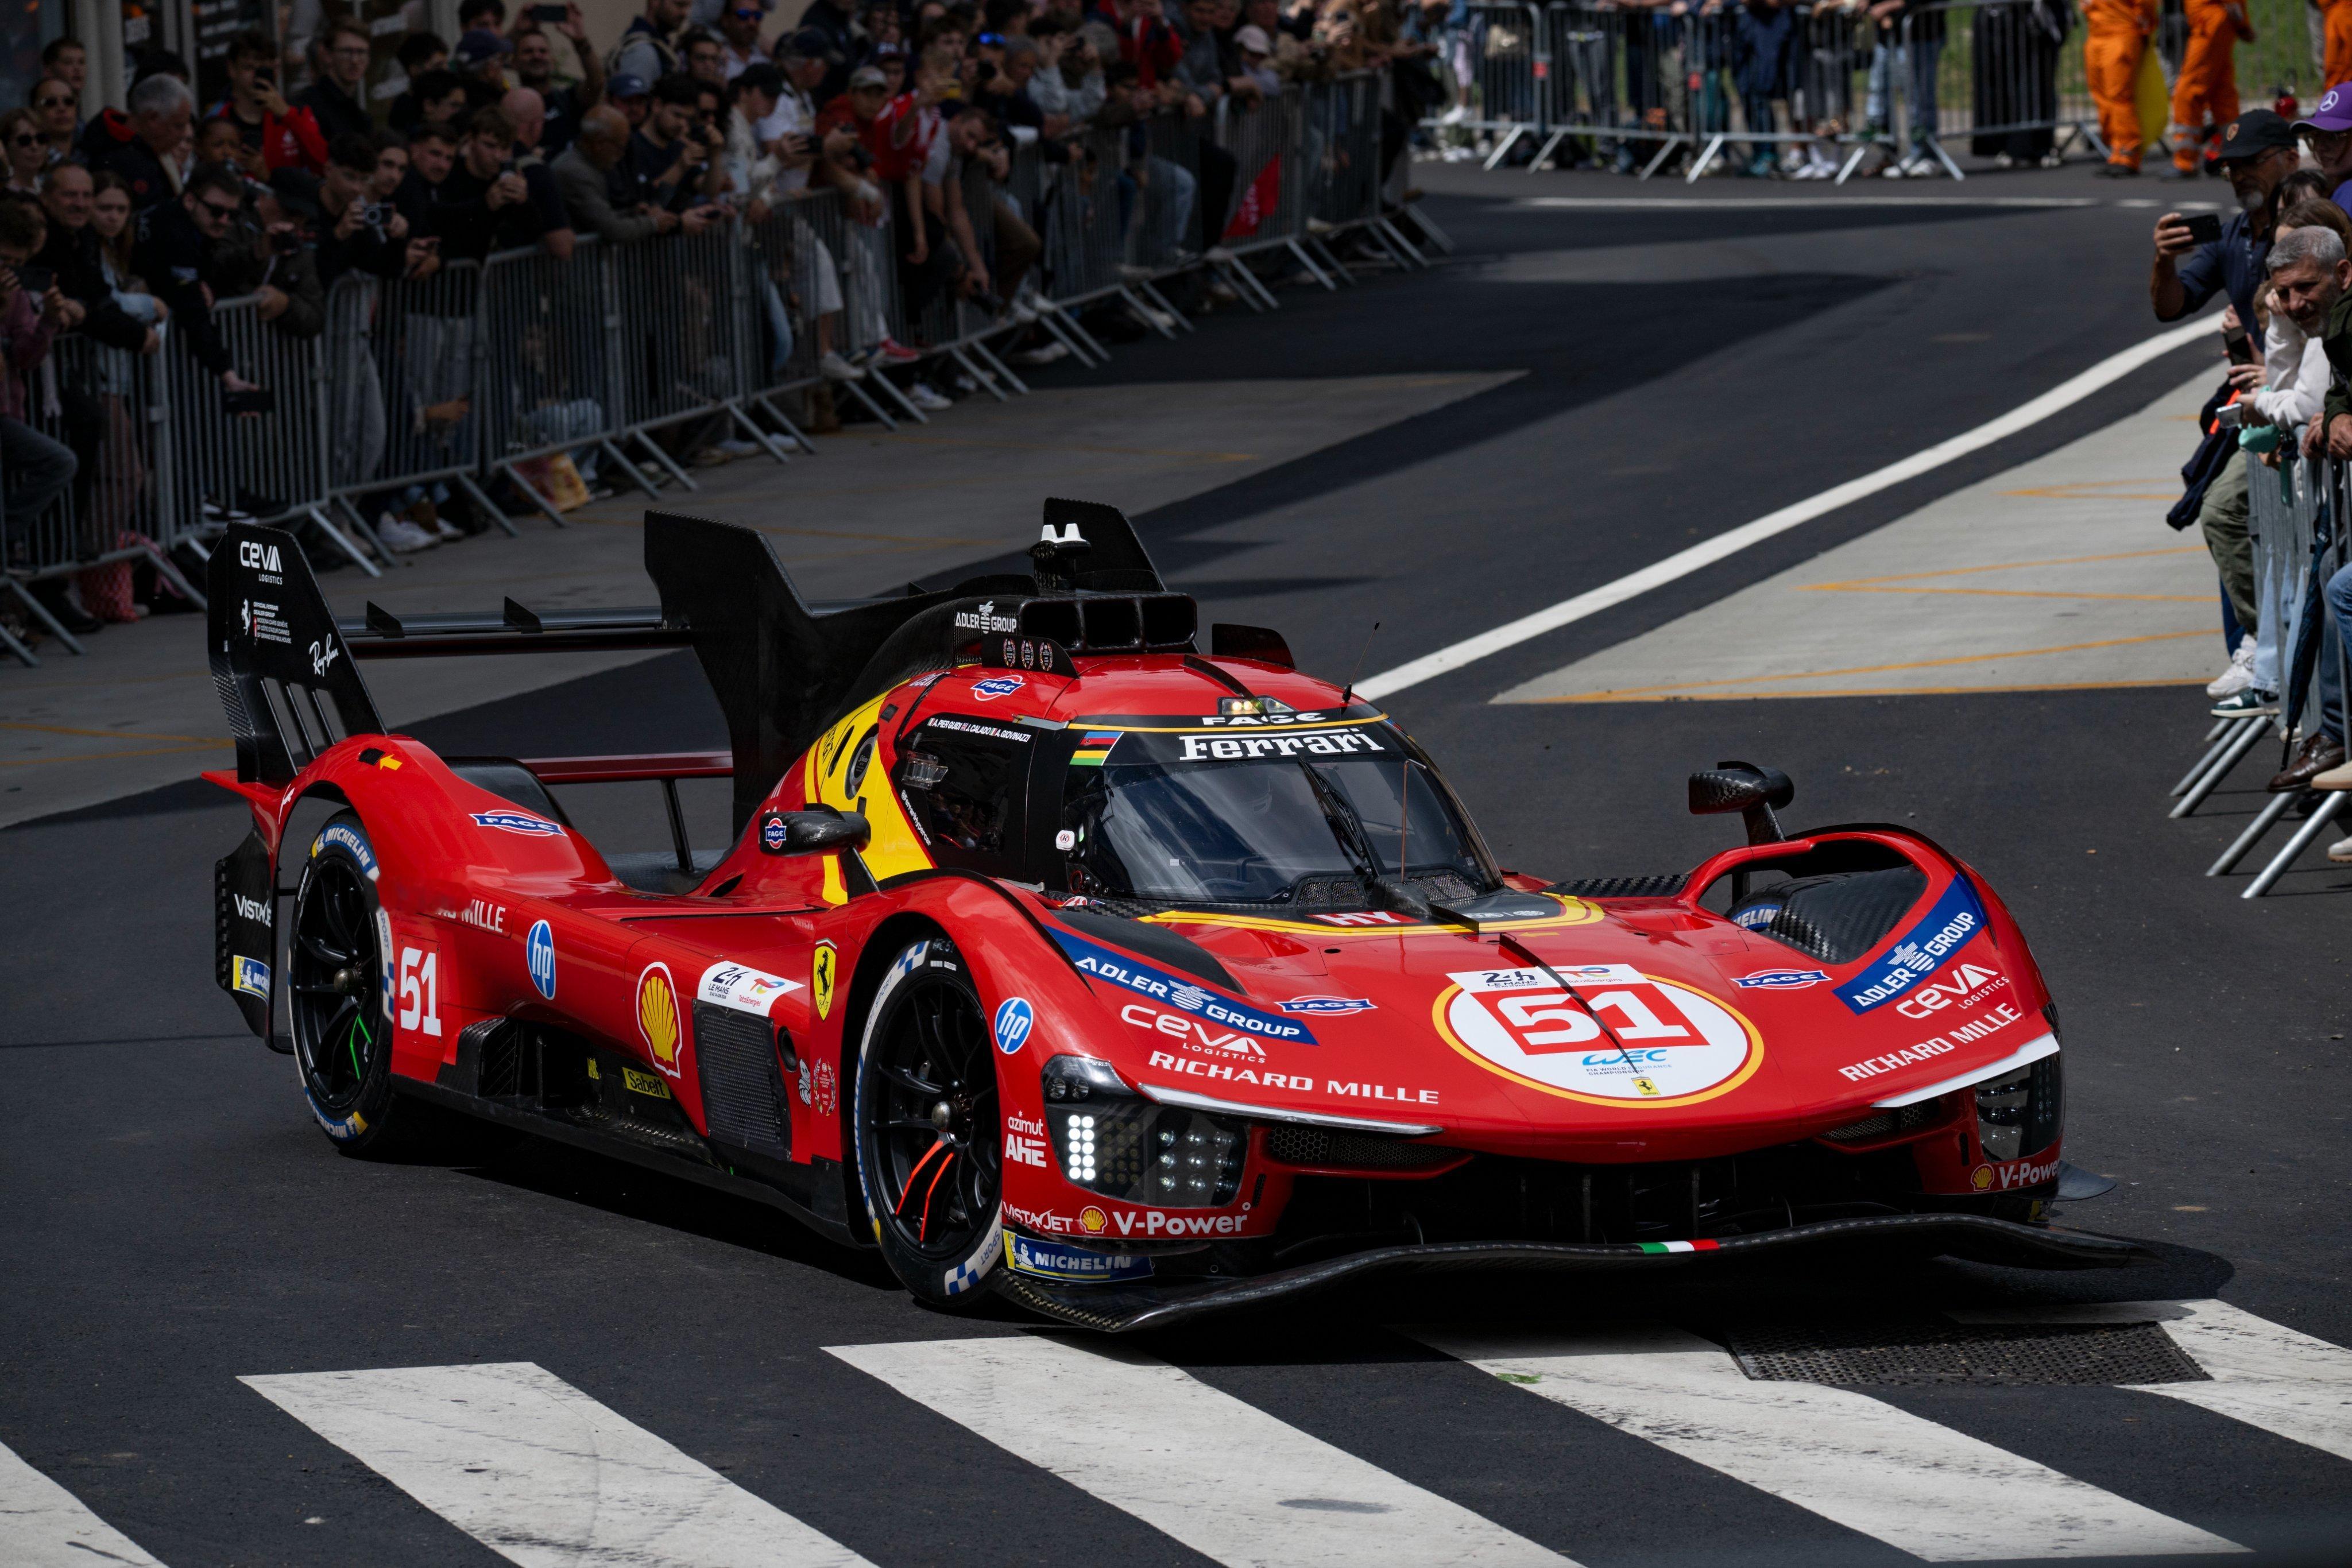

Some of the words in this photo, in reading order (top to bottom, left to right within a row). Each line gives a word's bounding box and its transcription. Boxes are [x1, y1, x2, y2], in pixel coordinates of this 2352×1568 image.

[259, 574, 283, 585] LOGISTICS
[955, 612, 980, 629] ADLER
[991, 616, 1017, 633] GROUP
[938, 719, 948, 729] PIER
[948, 721, 962, 730] GUIDI
[969, 725, 991, 735] CALADO
[1001, 730, 1031, 742] GIOVINAZZI
[1179, 727, 1384, 761] Ferrari
[326, 828, 370, 868] MICHELIN
[234, 893, 272, 928] VISTAJE
[462, 899, 506, 933] MILLE
[1318, 911, 1401, 926] HY
[378, 911, 390, 950] SPORT
[1852, 967, 1917, 1007] ADLER
[1924, 912, 1975, 956] GROUP
[400, 946, 442, 1037] 51
[715, 985, 730, 994] MANS
[738, 995, 761, 1007] TotalEnergies
[1075, 957, 1169, 998] ADLER
[1206, 1004, 1299, 1037] GROUP
[1958, 976, 2010, 1009] LOGISTICS
[1498, 990, 1690, 1046] 51
[1183, 1043, 1266, 1063] LOGISTICS
[1838, 1037, 1955, 1082] RICHARD
[1948, 1002, 2022, 1044] MILLE
[1582, 1049, 1667, 1066] WEC
[628, 1070, 666, 1097] Sabelt
[1148, 1050, 1313, 1091] RICHARD
[1327, 1080, 1439, 1104] MILLE
[1008, 1111, 1043, 1137] azimut
[1003, 1201, 1074, 1233] VISTAJET
[1113, 1211, 1247, 1236] V-Power
[981, 1230, 1000, 1265] SPORT
[1034, 1252, 1131, 1271] MICHELIN
